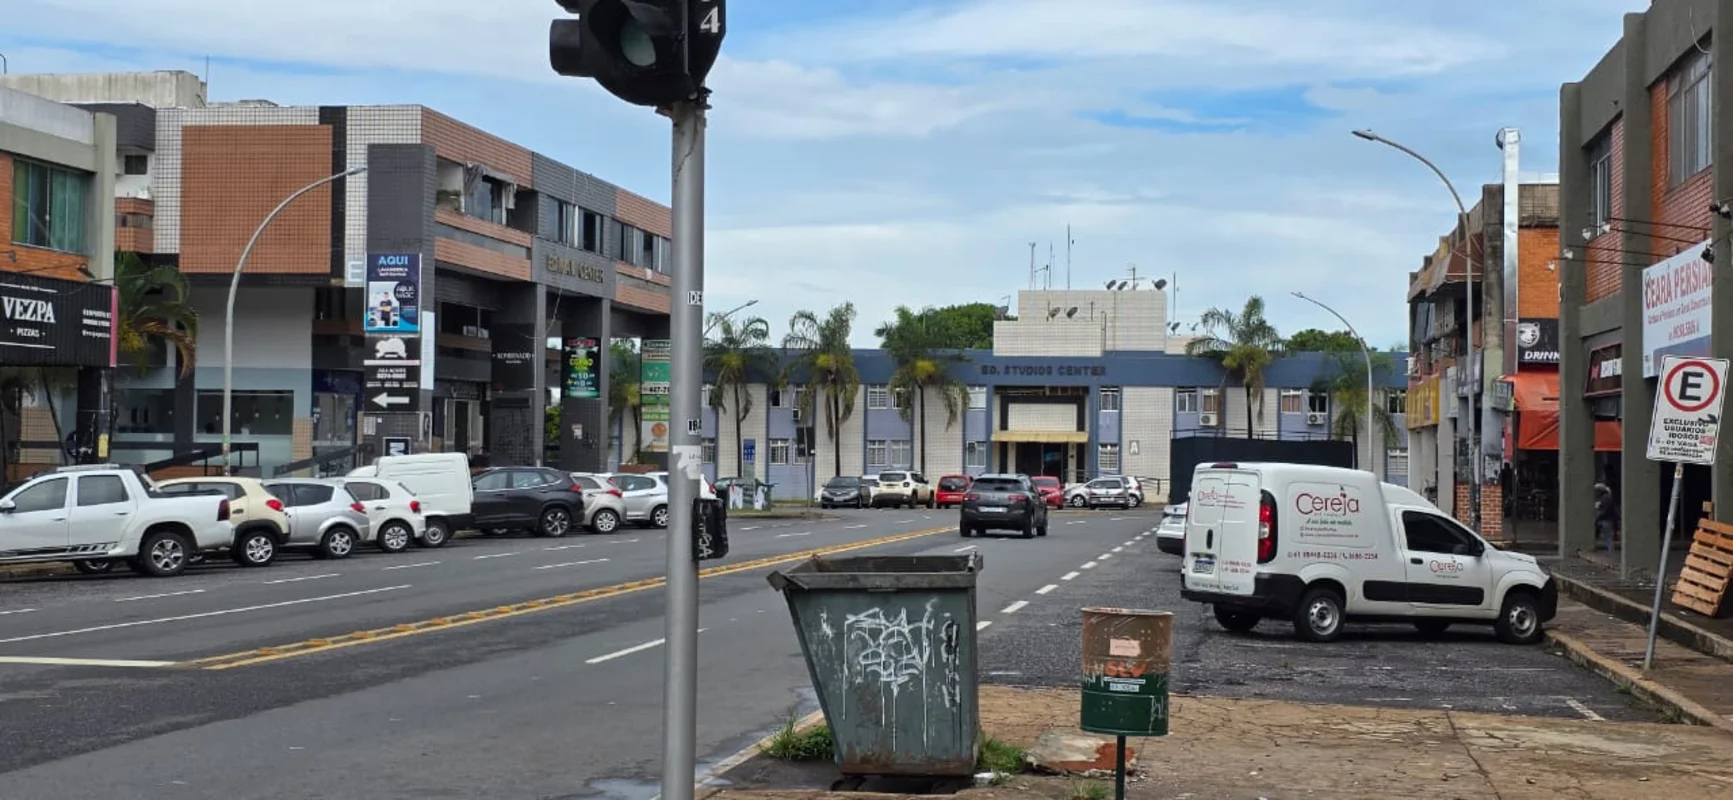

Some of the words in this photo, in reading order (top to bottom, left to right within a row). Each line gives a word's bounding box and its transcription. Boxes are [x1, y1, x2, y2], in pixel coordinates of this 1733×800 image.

[700, 6, 721, 33] 4
[379, 256, 408, 265] AQUI
[2, 297, 56, 323] VEZPA
[17, 328, 40, 337] PIZZAS
[1004, 364, 1053, 376] STUDIOS
[1057, 365, 1106, 377] CENTER
[1679, 371, 1704, 401] E
[1669, 433, 1699, 441] IDOSOS
[1130, 441, 1138, 453] A
[1296, 490, 1360, 517] Cereja
